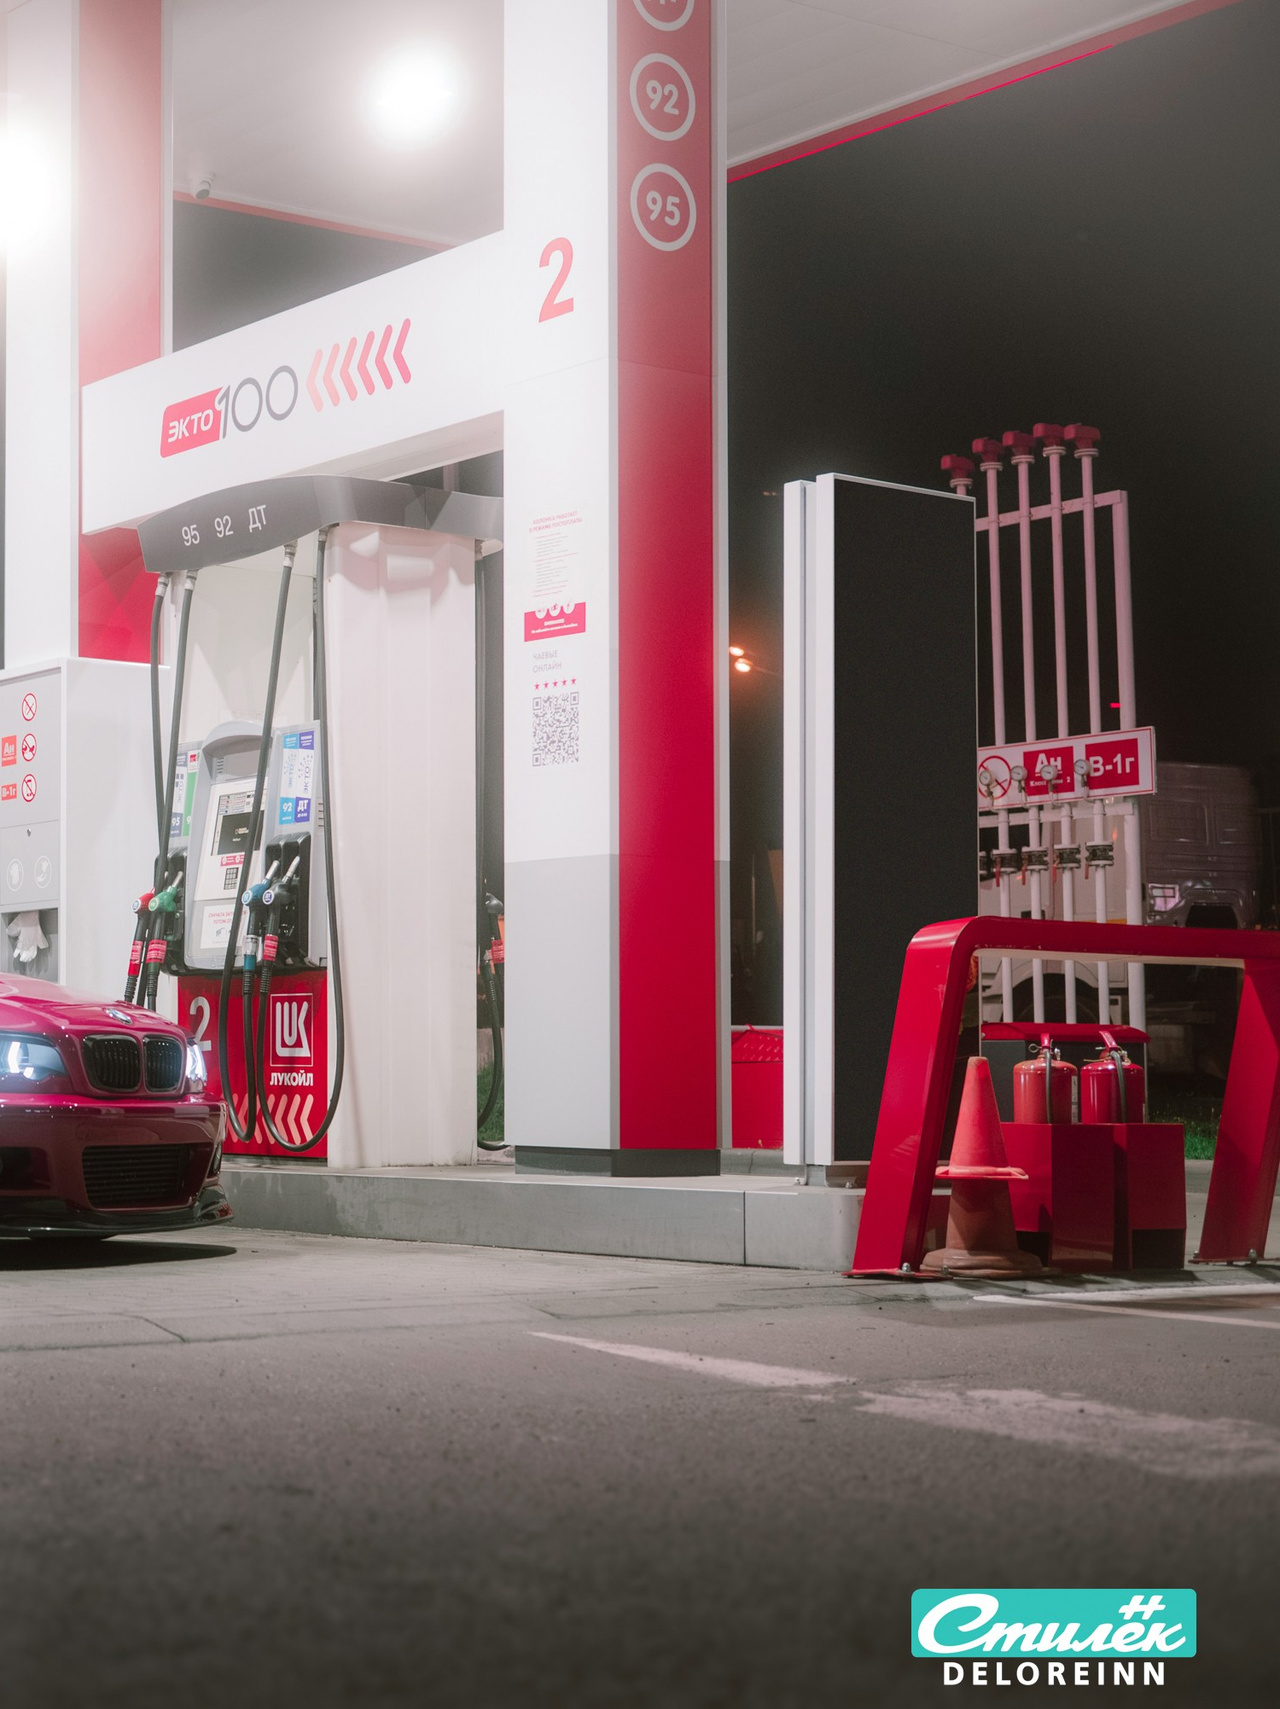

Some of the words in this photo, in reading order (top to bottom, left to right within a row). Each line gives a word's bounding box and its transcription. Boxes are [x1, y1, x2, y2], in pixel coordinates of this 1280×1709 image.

[645, 80, 679, 115] 92
[646, 190, 680, 227] 95
[538, 237, 574, 323] 2
[167, 409, 214, 443] ЭКТО
[217, 365, 298, 440] 100
[181, 524, 200, 547] 95
[214, 515, 234, 538] 92
[248, 505, 268, 533] ДТ
[1035, 753, 1062, 773] Ан
[282, 802, 292, 812] 92
[297, 800, 308, 812] ДТ
[189, 996, 212, 1051] 2
[270, 1070, 314, 1087] ЛУКОЙЛ
